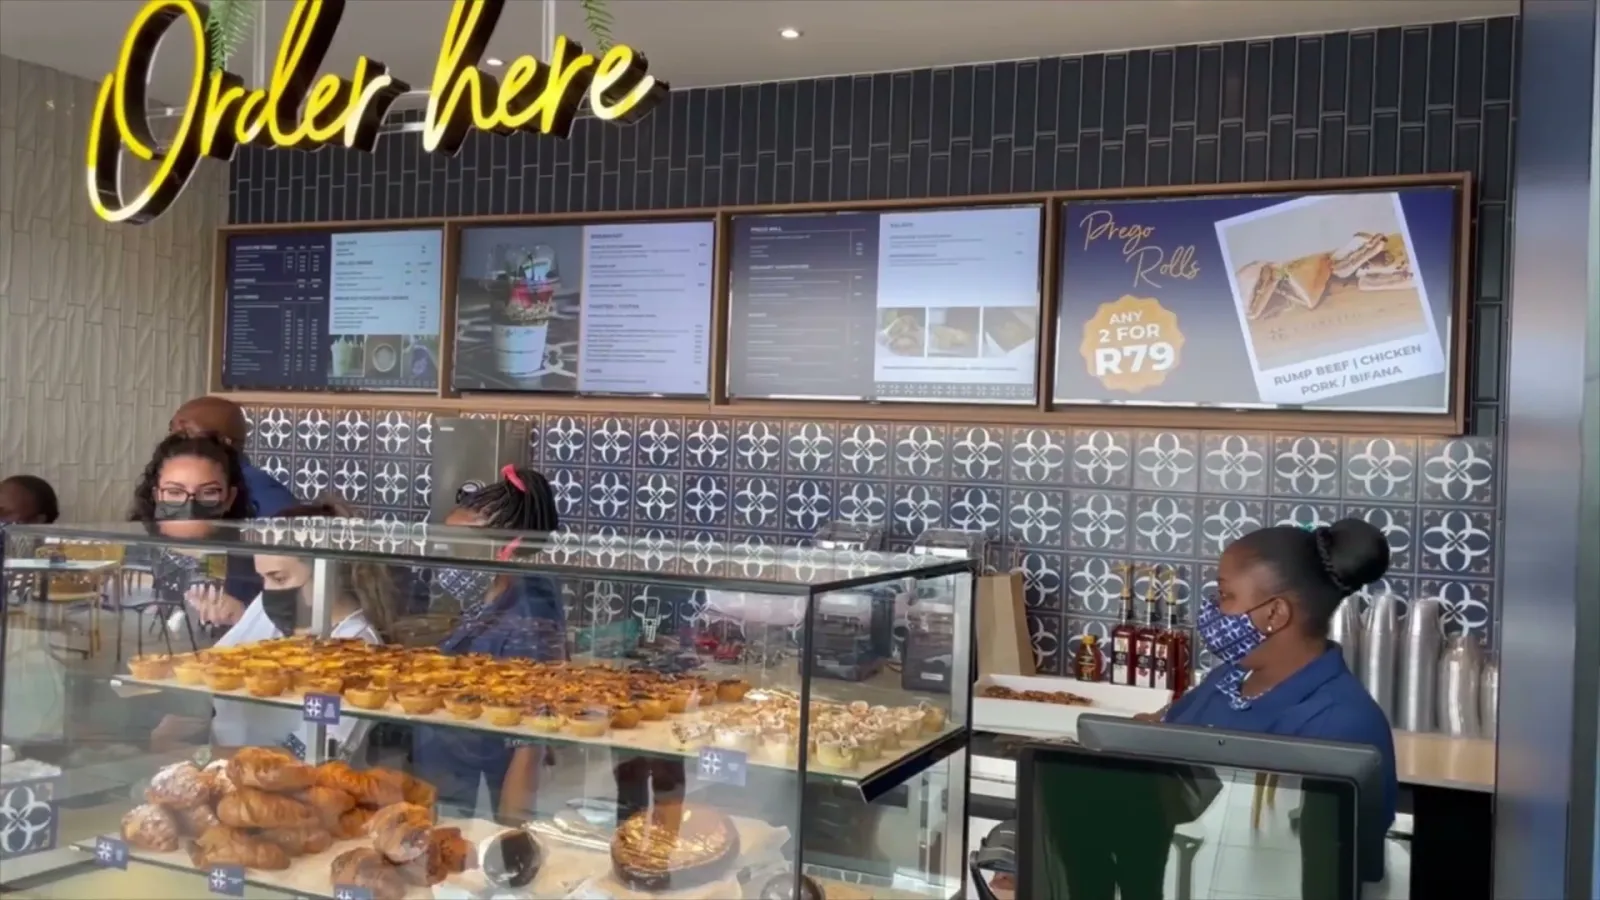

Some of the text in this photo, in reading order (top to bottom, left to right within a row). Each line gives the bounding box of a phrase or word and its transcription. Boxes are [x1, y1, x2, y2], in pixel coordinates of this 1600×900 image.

[87, 0, 656, 222] Order here
[1079, 210, 1156, 255] Prego
[1125, 245, 1201, 289] Rolls
[1098, 323, 1161, 344] 2 FOR
[1109, 310, 1144, 326] ANY
[1095, 341, 1175, 377] R79
[1273, 368, 1313, 386] RUMP
[1315, 359, 1350, 377] BEEF
[1360, 343, 1422, 366] CHICKEN
[1301, 379, 1339, 396] PORK
[1349, 364, 1403, 385] BIFANA
